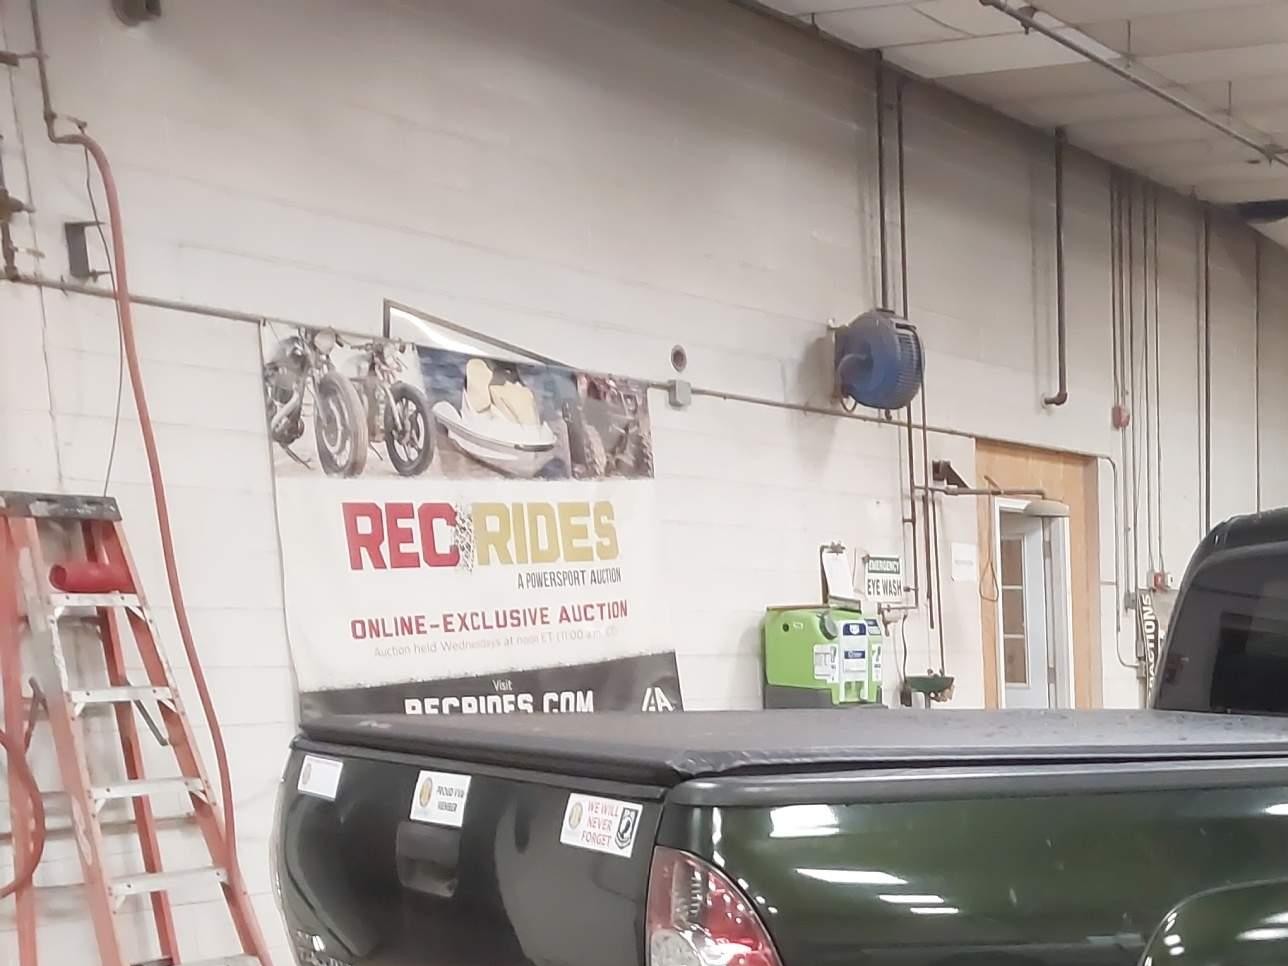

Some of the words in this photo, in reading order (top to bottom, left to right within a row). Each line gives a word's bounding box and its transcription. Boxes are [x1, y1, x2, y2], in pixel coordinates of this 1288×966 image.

[342, 502, 460, 570] REC
[471, 501, 620, 566] RIDES
[868, 559, 899, 574] EMERGENCY
[517, 572, 524, 590] A
[526, 570, 586, 588] POWERSPORT
[590, 567, 622, 586] AUCTION
[867, 579, 880, 596] EYE
[882, 579, 902, 597] WASH
[351, 607, 550, 640] ONLINE-EXCLUSIVE
[558, 599, 628, 624] AUCTION
[374, 643, 410, 657] Auction
[414, 640, 437, 654] held
[492, 679, 513, 692] Visit
[588, 800, 600, 814] WE
[601, 803, 619, 817] WILL
[587, 816, 612, 832] NEVER
[582, 830, 612, 848] FORGET
